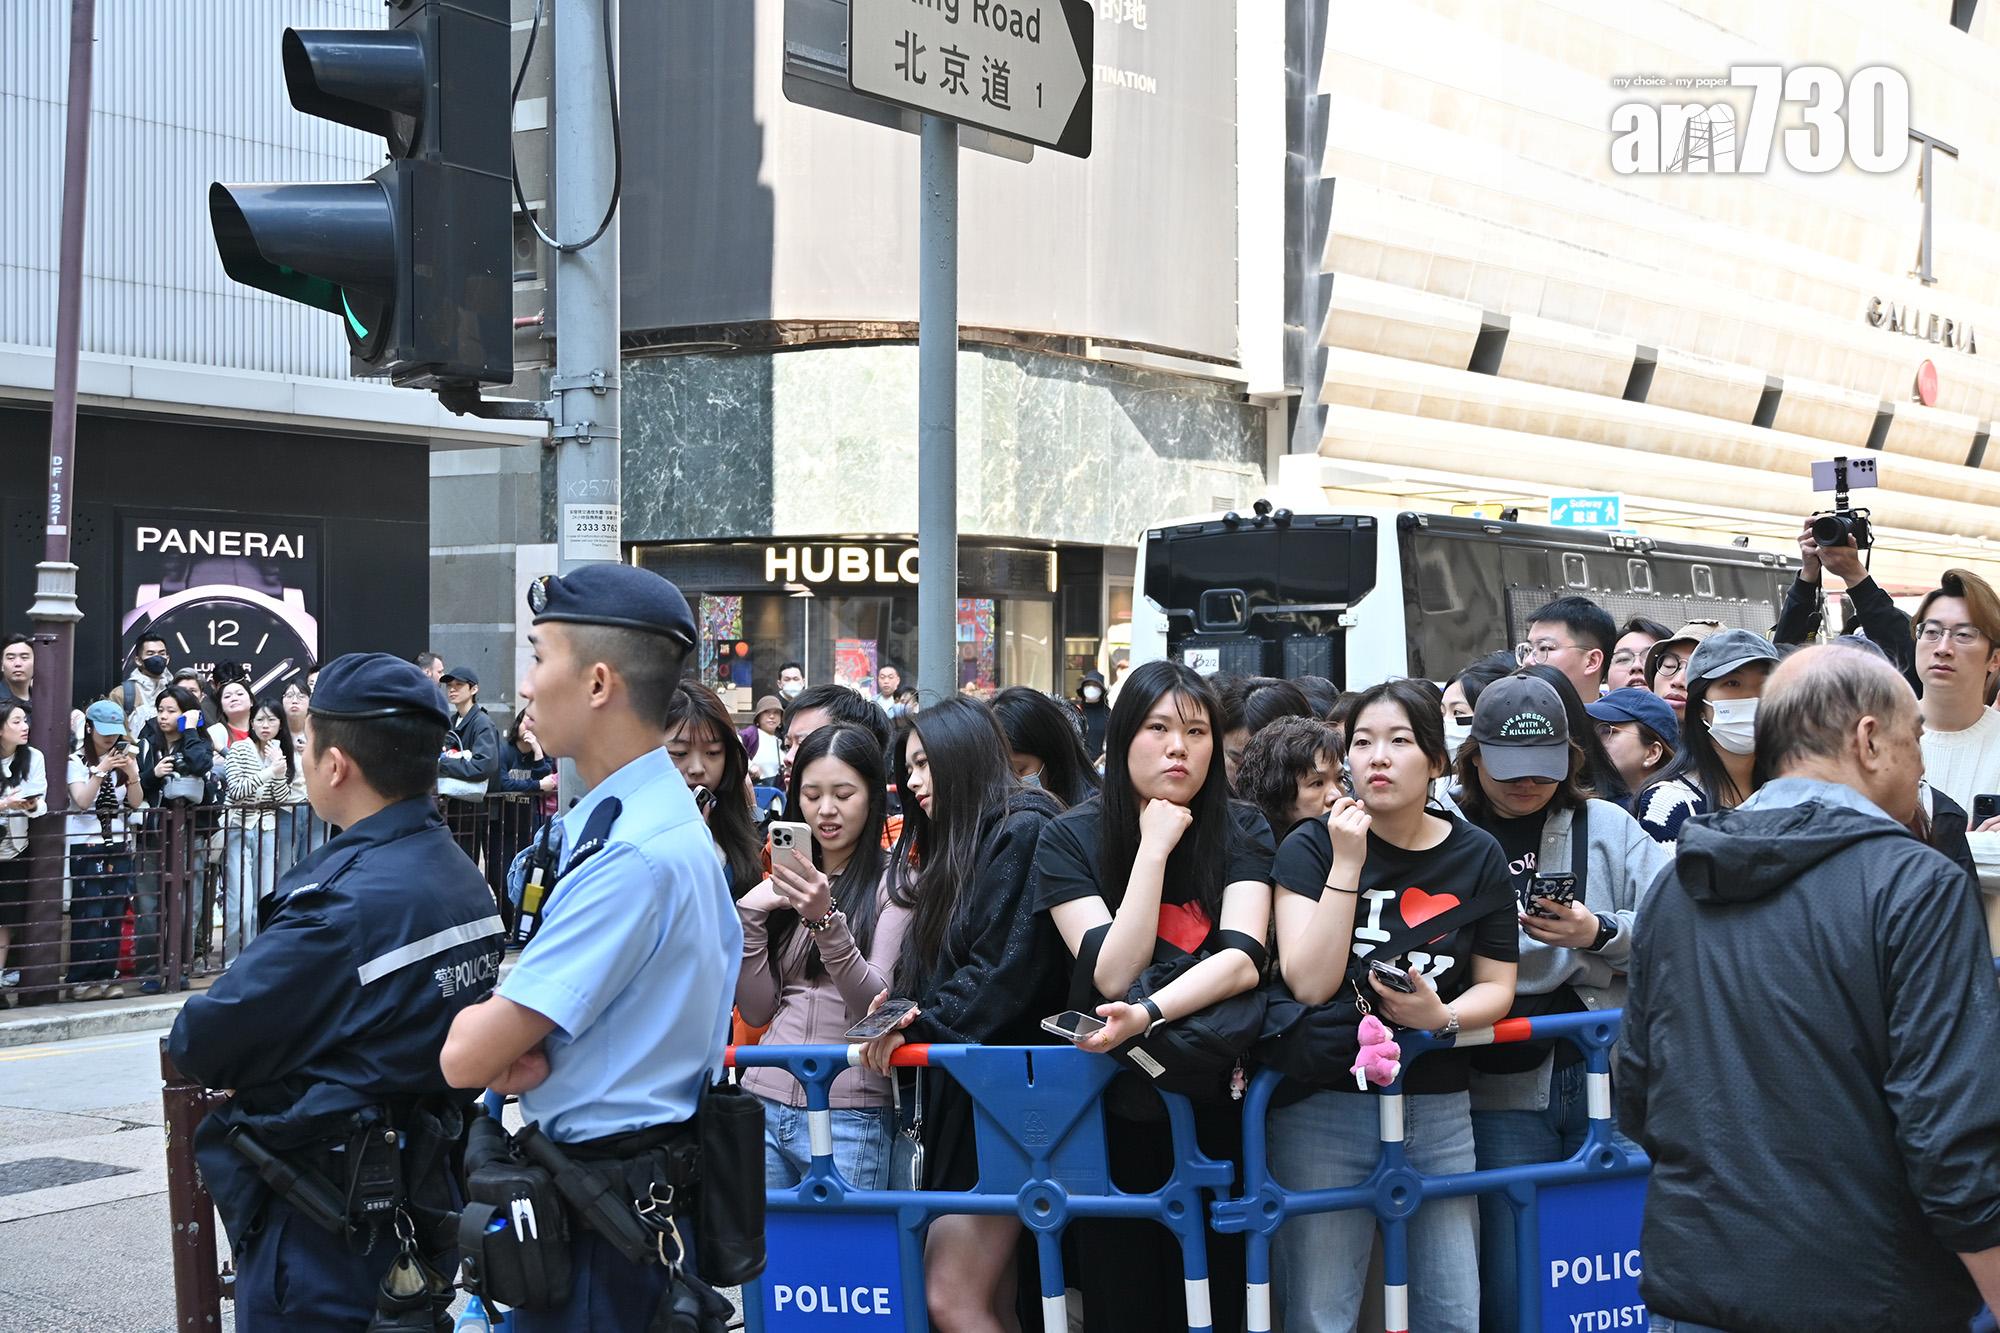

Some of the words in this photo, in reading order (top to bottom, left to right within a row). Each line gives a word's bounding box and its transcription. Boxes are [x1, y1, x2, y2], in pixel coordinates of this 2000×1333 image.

[973, 0, 1041, 44] Road
[894, 29, 1012, 112] 北京道
[1036, 82, 1043, 109] 1
[1093, 64, 1157, 95] TINATION
[1866, 296, 1977, 355] GALLERIA
[50, 482, 62, 525] 1221
[136, 526, 305, 560] PANERAI
[576, 523, 599, 532] 2333
[765, 546, 920, 584] HUBLO
[207, 619, 240, 646] 12
[1500, 717, 1515, 736] HAVE
[1522, 712, 1546, 722] FRESH
[1545, 720, 1555, 736] DAY
[1354, 888, 1397, 943] I
[434, 966, 456, 998] 警
[1551, 1249, 1642, 1288] POLIC
[774, 1285, 891, 1315] POLICE
[1569, 1304, 1646, 1333] YTDIST
